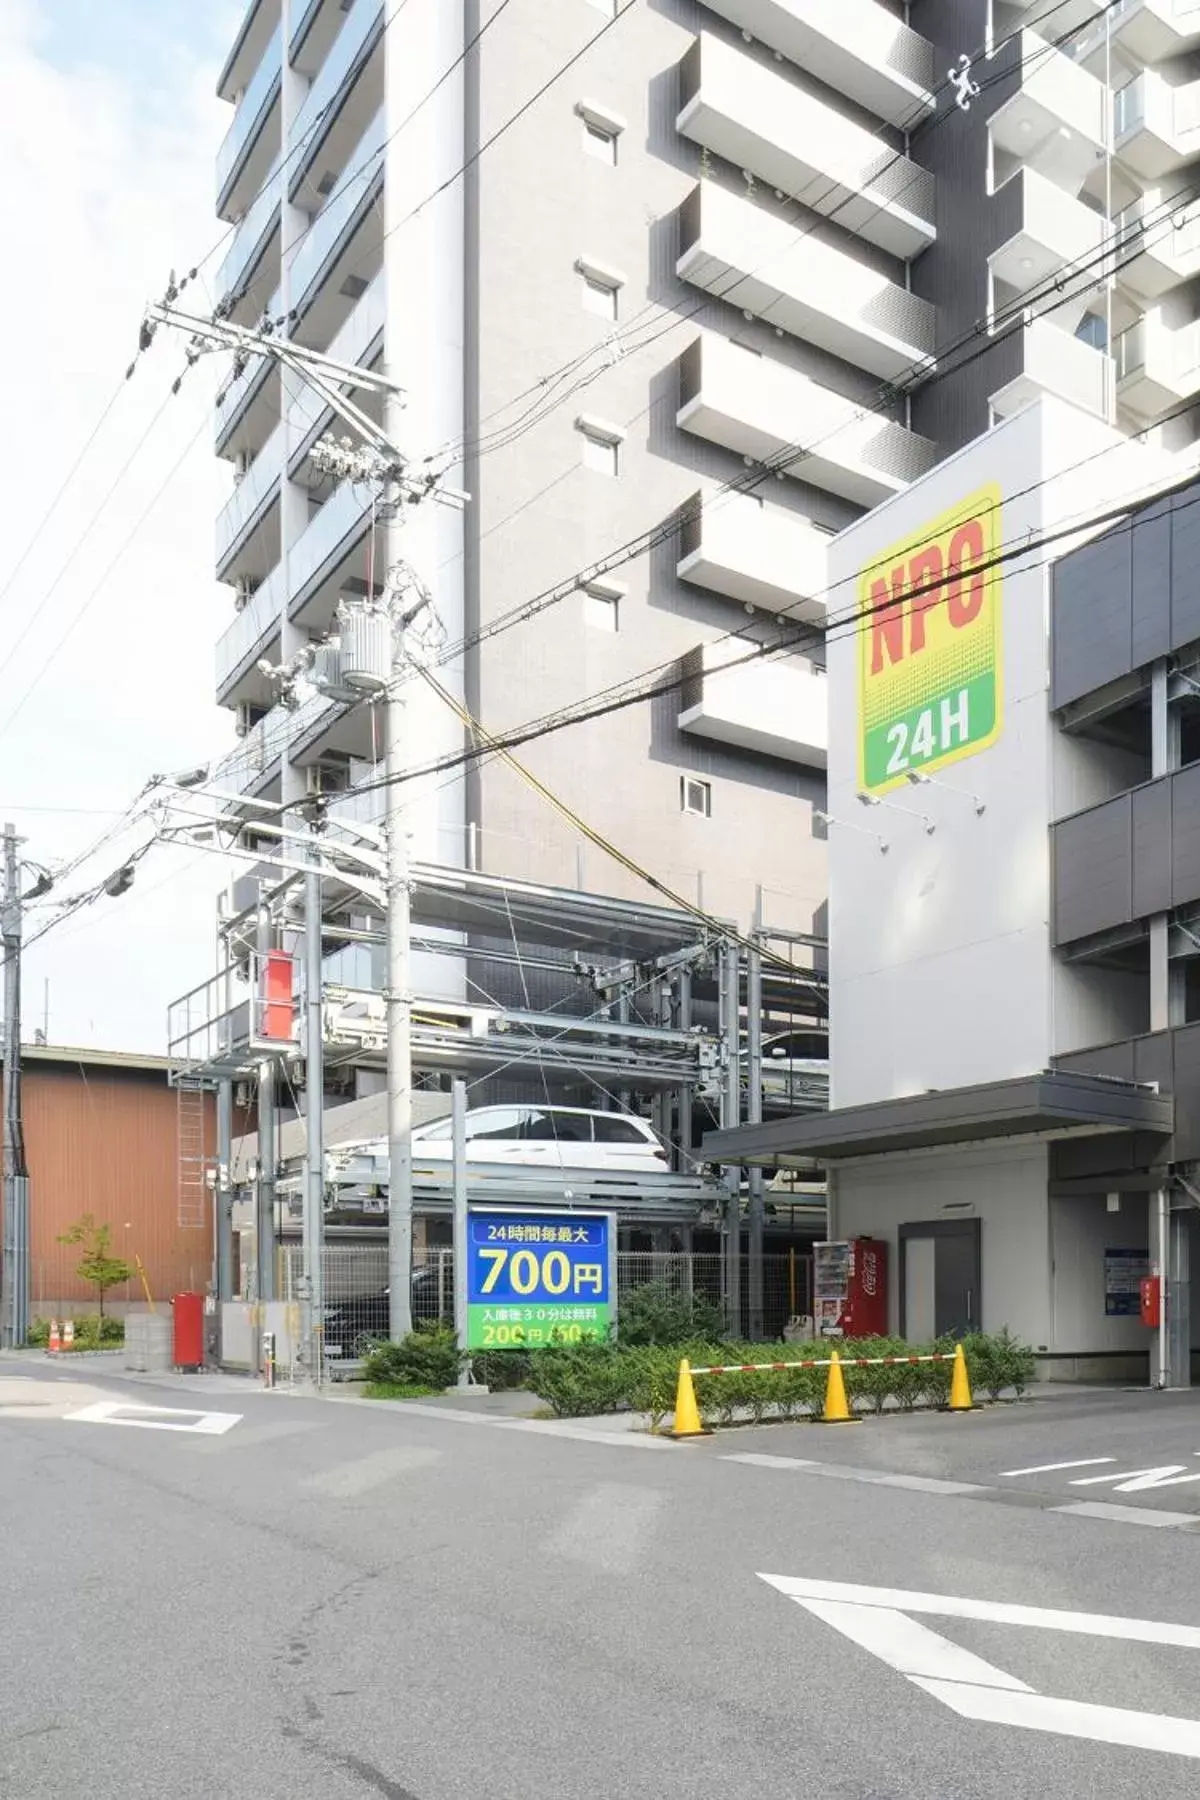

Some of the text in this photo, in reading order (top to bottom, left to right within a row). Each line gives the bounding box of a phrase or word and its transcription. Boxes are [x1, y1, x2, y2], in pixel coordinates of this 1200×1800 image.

[870, 519, 984, 677] NPC
[886, 688, 969, 775] 24H
[488, 1225, 589, 1243] 24時間毎最大
[479, 1249, 602, 1294] 700円
